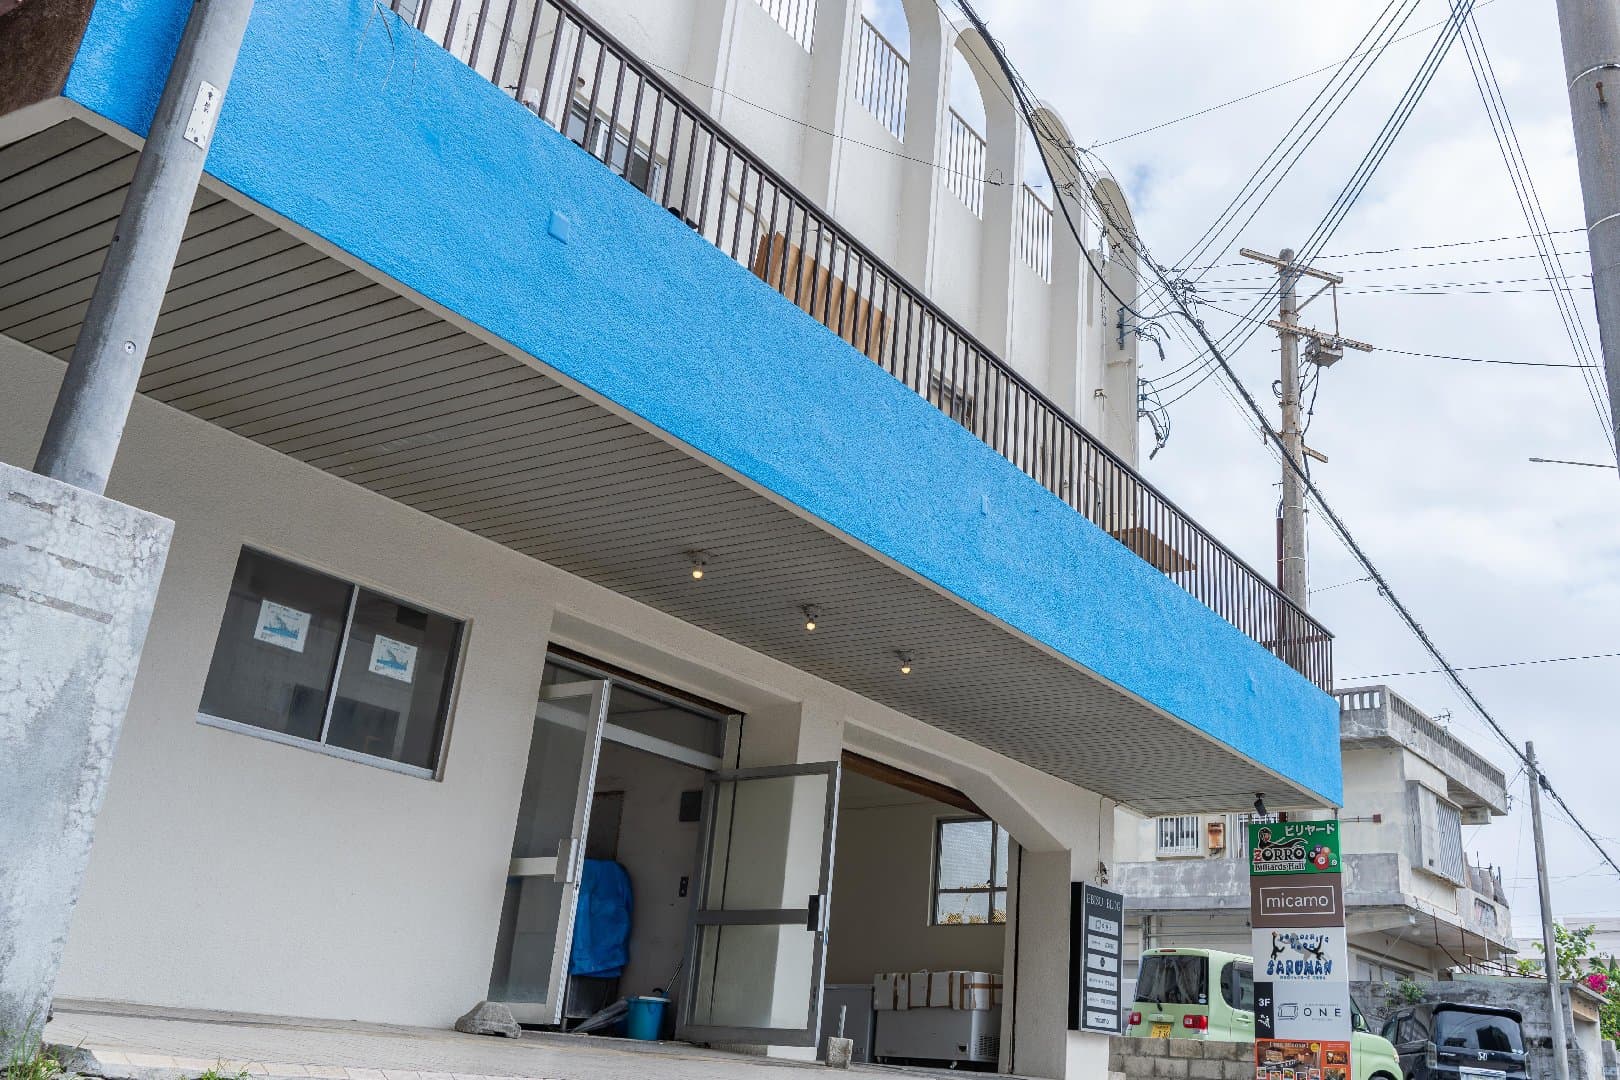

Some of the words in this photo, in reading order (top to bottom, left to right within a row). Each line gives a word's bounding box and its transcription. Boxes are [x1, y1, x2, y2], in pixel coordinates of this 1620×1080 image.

[1285, 824, 1335, 836] ビリヤード
[1254, 847, 1305, 861] ZORRO
[1266, 892, 1329, 908] micamo
[1259, 998, 1270, 1007] 3F
[1303, 1007, 1342, 1017] ONE
